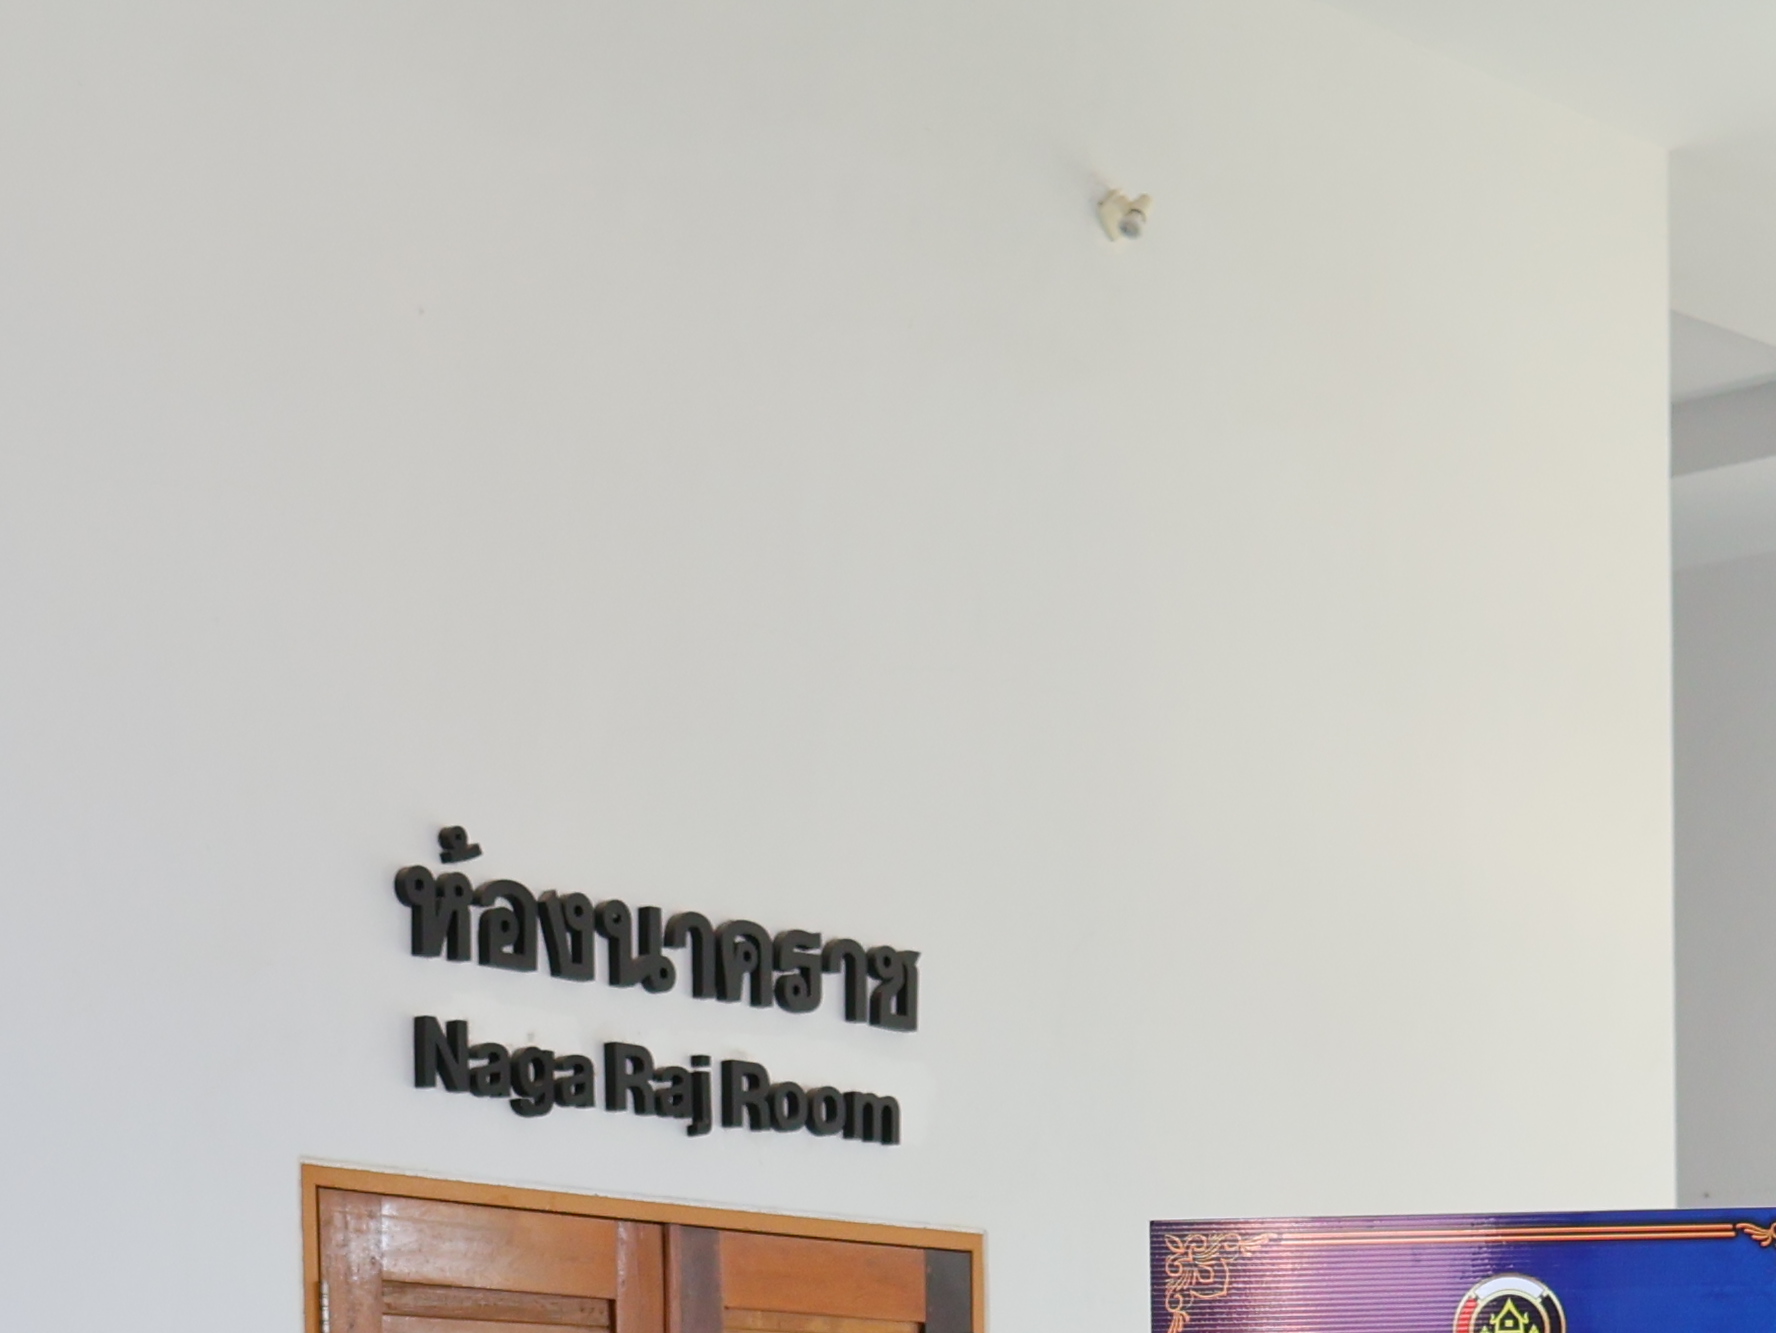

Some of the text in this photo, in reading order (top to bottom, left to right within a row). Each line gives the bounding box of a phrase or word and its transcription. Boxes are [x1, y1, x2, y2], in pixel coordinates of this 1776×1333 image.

[395, 825, 920, 1032] ห้องนาคราช
[413, 1014, 901, 1145] Naga Raj Room
